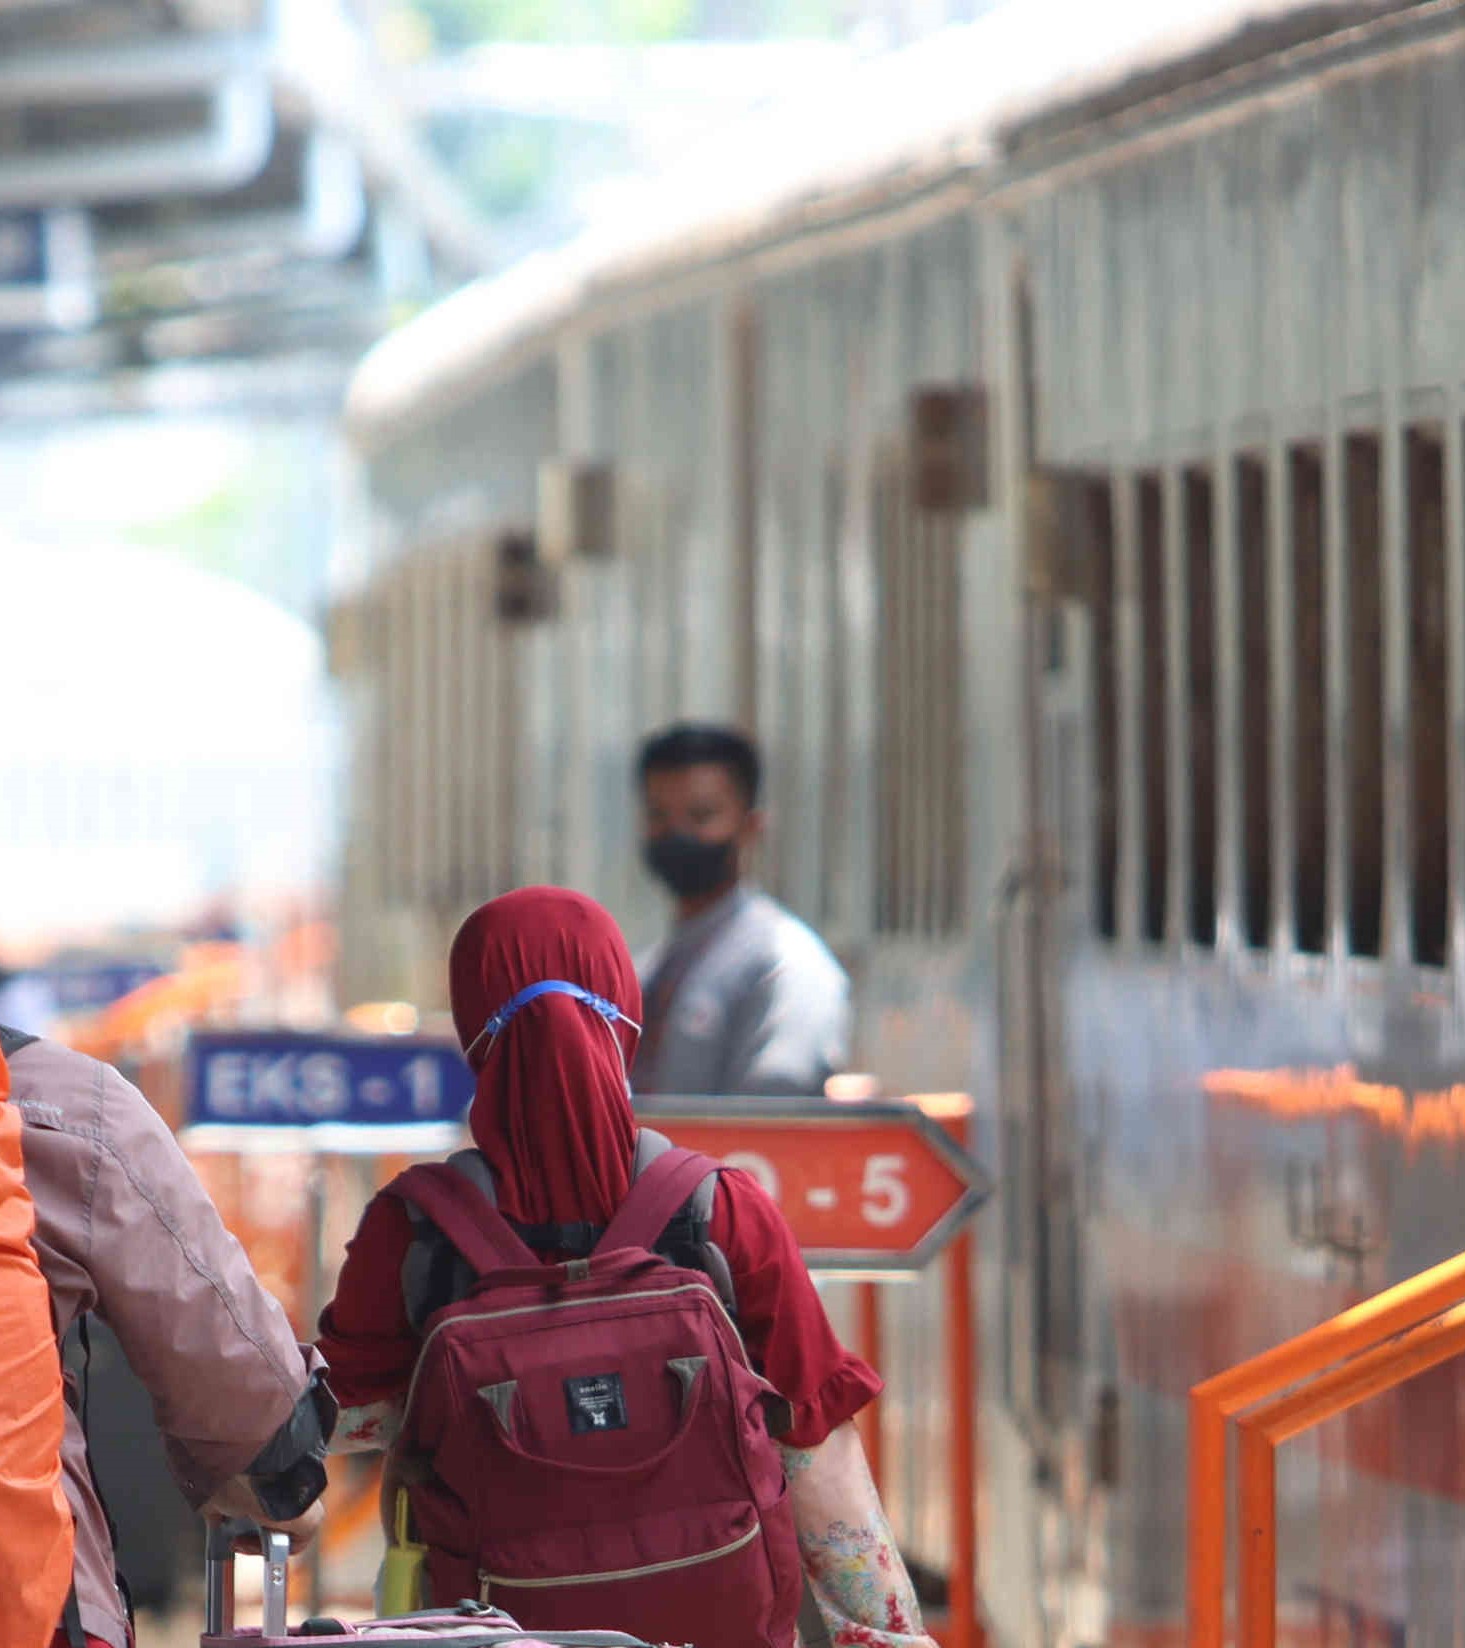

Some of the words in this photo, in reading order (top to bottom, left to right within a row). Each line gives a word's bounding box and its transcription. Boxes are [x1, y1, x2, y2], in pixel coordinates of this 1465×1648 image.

[206, 1051, 349, 1118] EKS
[400, 1053, 441, 1117] 1
[861, 1152, 910, 1230] 5
